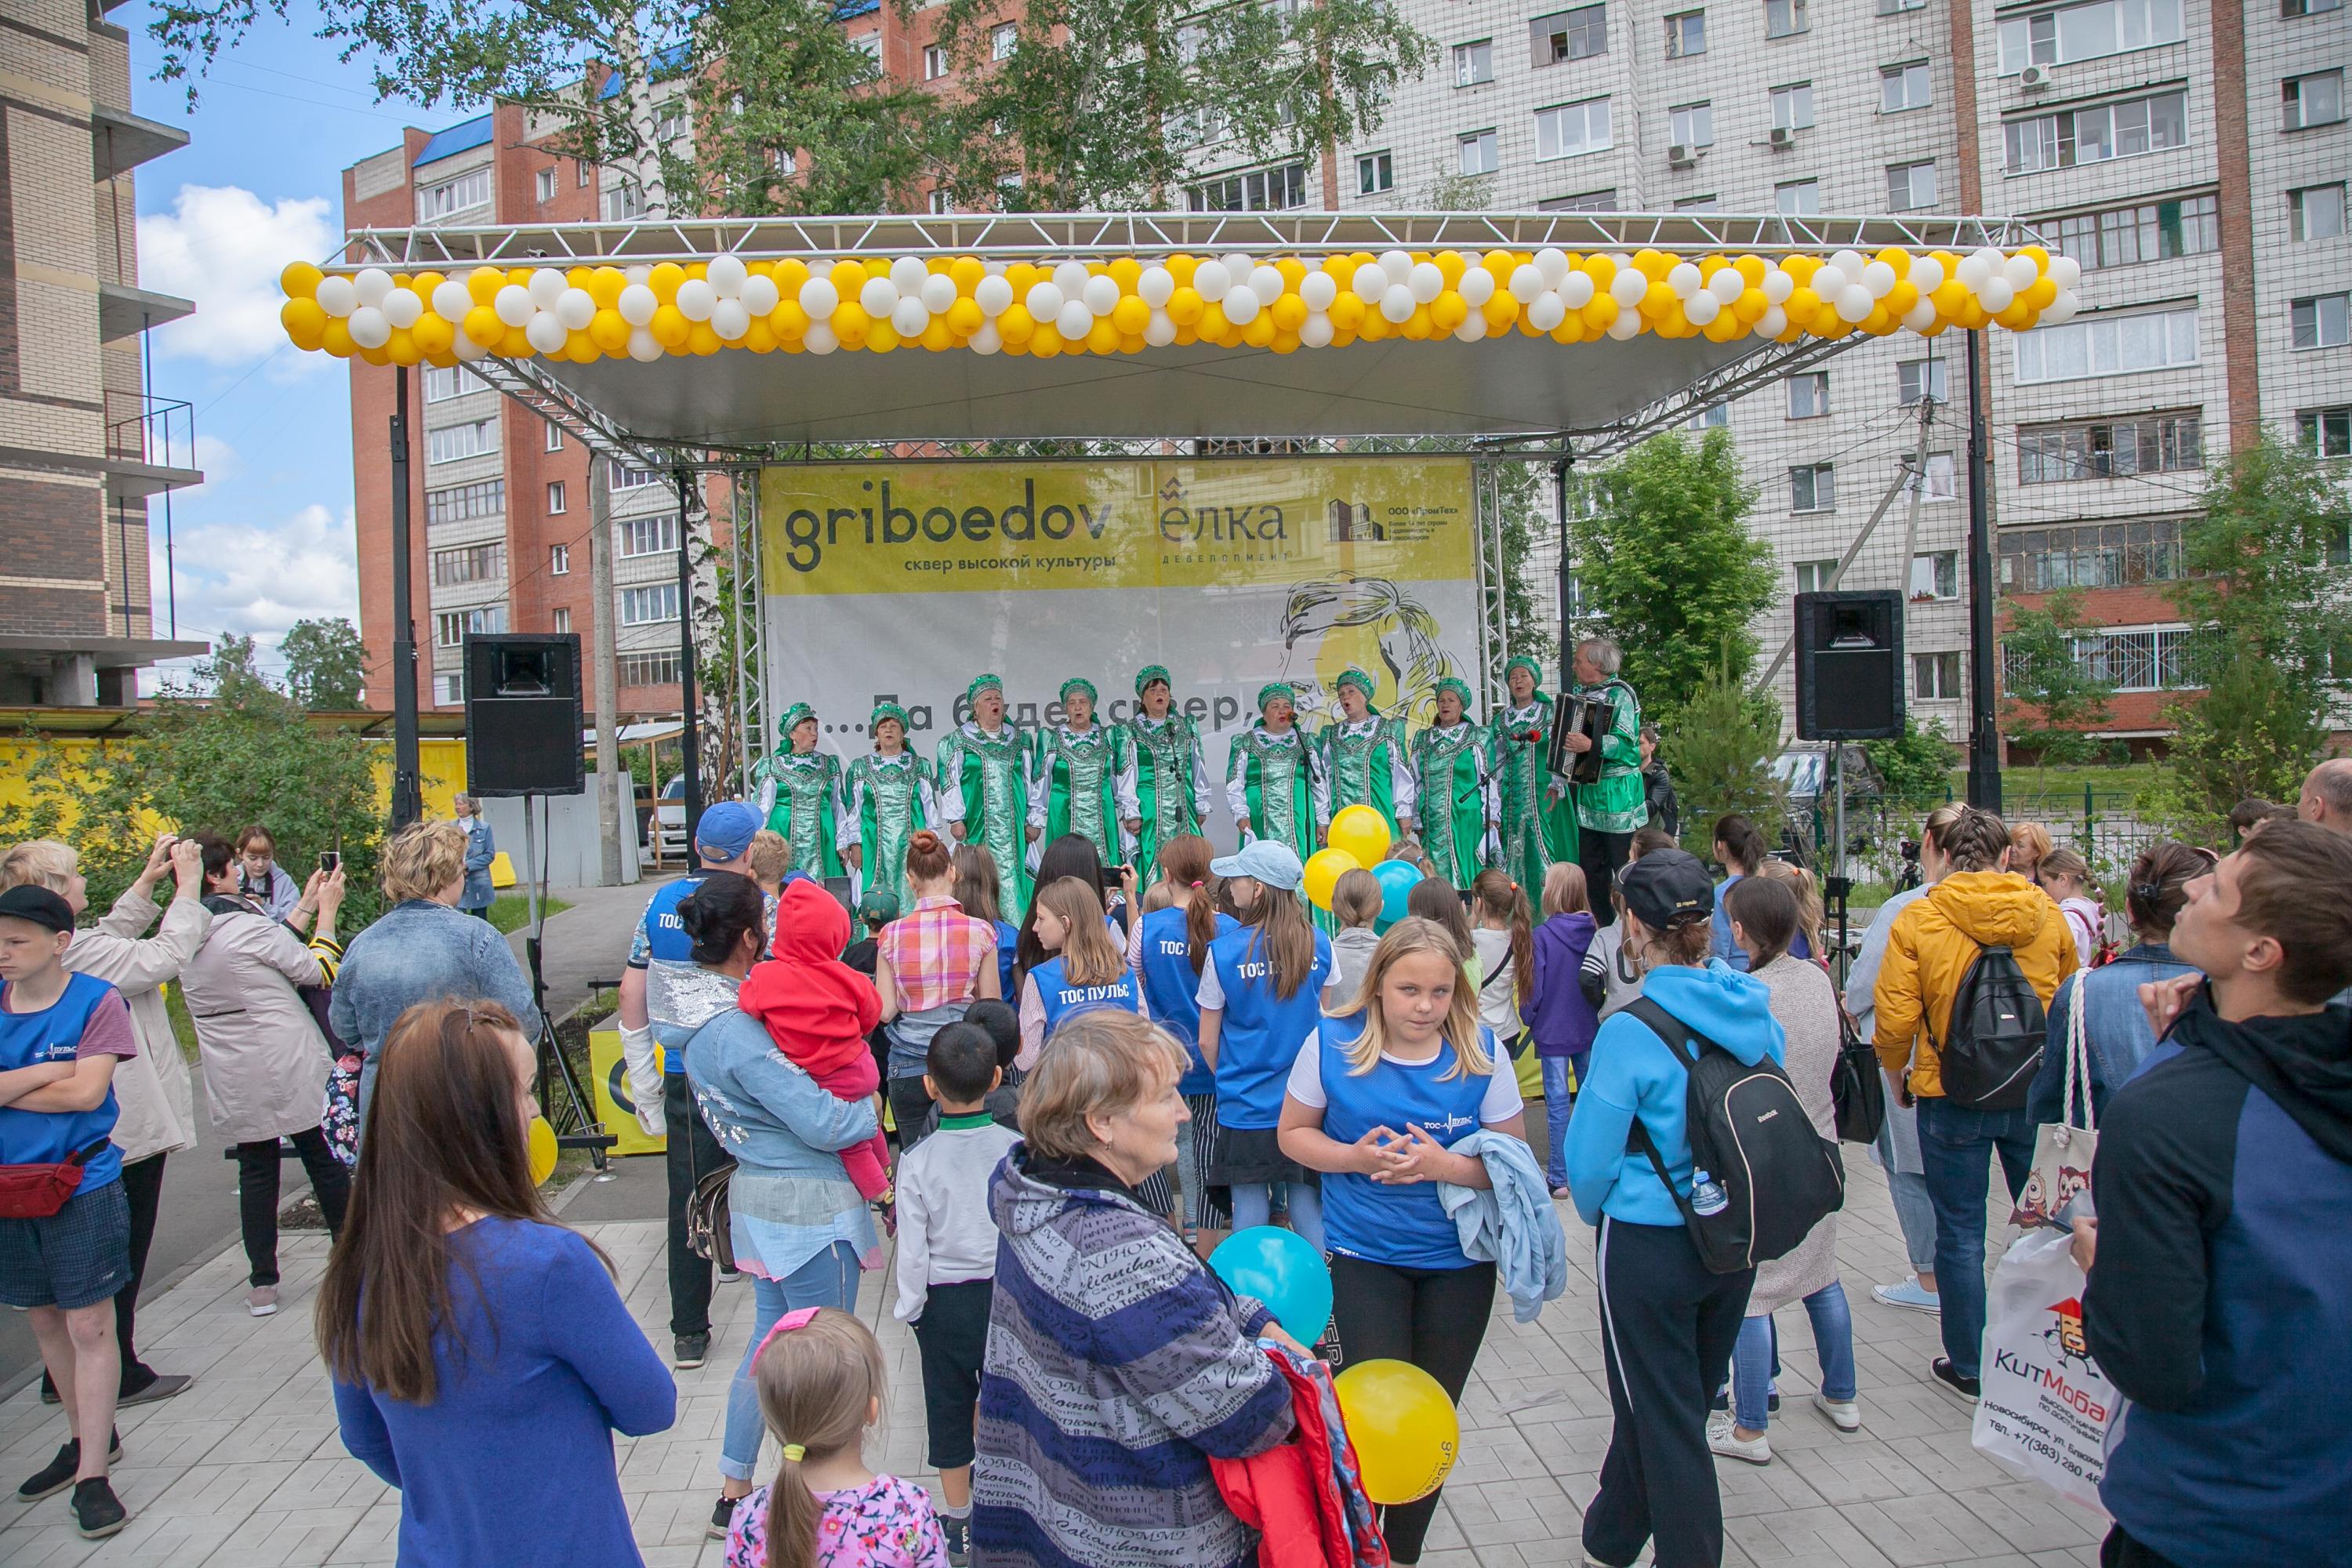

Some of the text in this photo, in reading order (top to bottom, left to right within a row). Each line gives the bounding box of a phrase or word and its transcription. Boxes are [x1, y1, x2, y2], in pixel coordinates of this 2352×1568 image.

[1388, 506, 1409, 516] ООО
[786, 478, 1112, 572] griboedov
[904, 554, 1116, 574] сквер высокой культуры
[1163, 554, 1289, 565] ДЕВЕЛОПМЕНТ
[659, 913, 683, 930] ТОС
[1160, 940, 1185, 956] ТОС
[1237, 962, 1265, 979] ТОС
[1059, 983, 1130, 1004] ТОС ПУЛЬС
[1452, 1116, 1473, 1125] ПУЛЬС
[1994, 1348, 2110, 1423] КитМоба
[1989, 1419, 2010, 1436] тел.
[2013, 1432, 2060, 1464] +7(383)
[2061, 1457, 2082, 1476] 280
